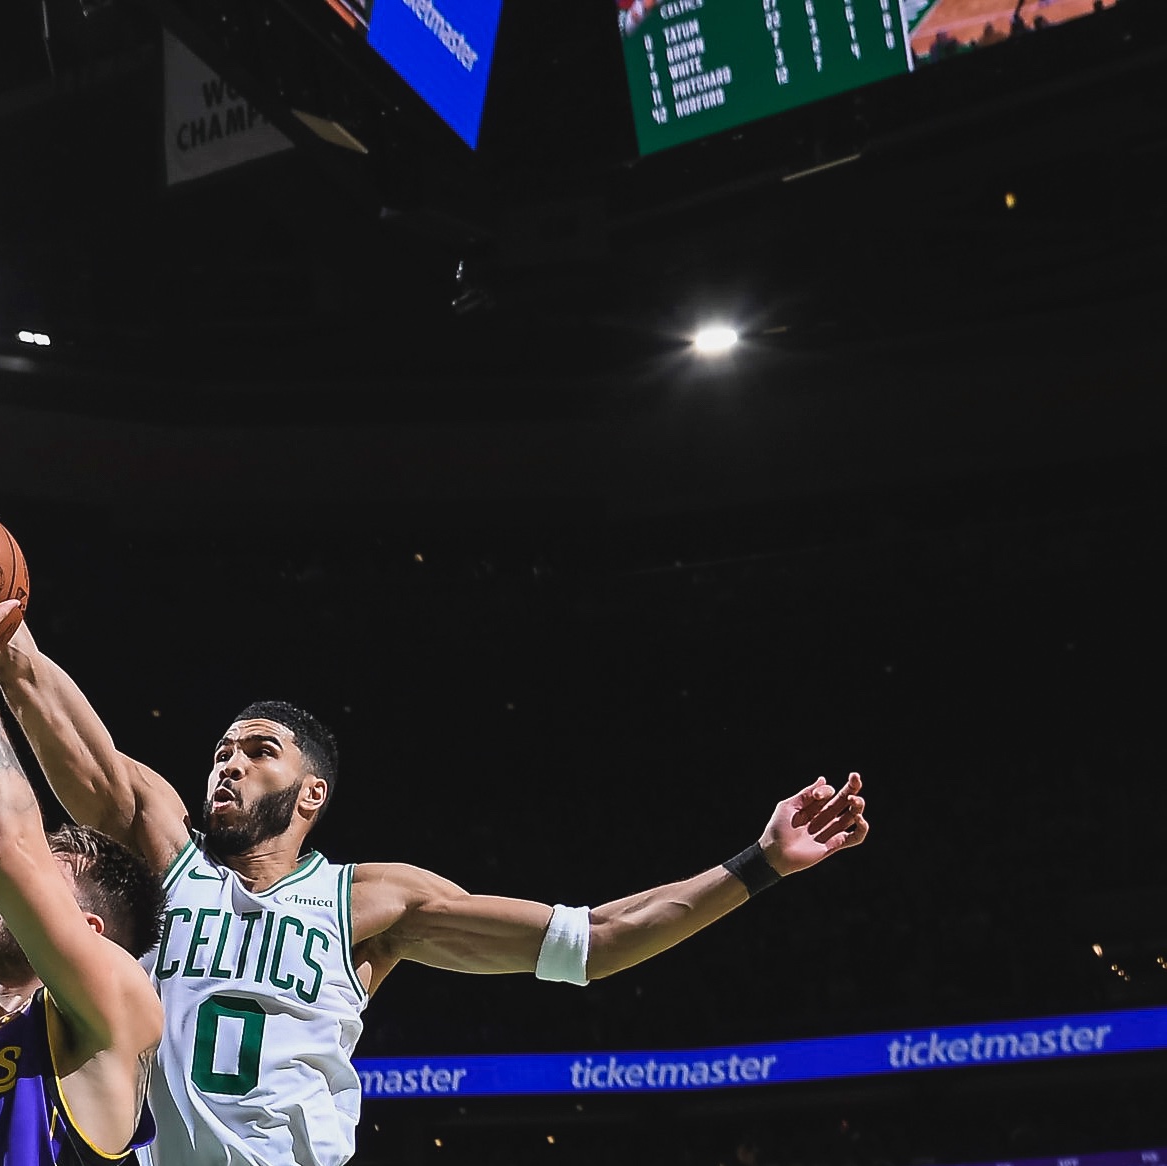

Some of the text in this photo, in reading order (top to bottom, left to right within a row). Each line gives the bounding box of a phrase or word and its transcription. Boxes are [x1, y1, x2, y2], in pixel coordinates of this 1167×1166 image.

[662, 17, 700, 45] TATUM
[666, 36, 705, 64] BROWN
[668, 54, 702, 81] WHITE
[672, 64, 732, 101] PRITCHARD
[285, 893, 334, 909] Amica
[154, 907, 330, 1004] CELTICS
[190, 993, 268, 1097] 0
[570, 1053, 776, 1089] ticketmaster
[888, 1023, 1112, 1068] ticketmaster
